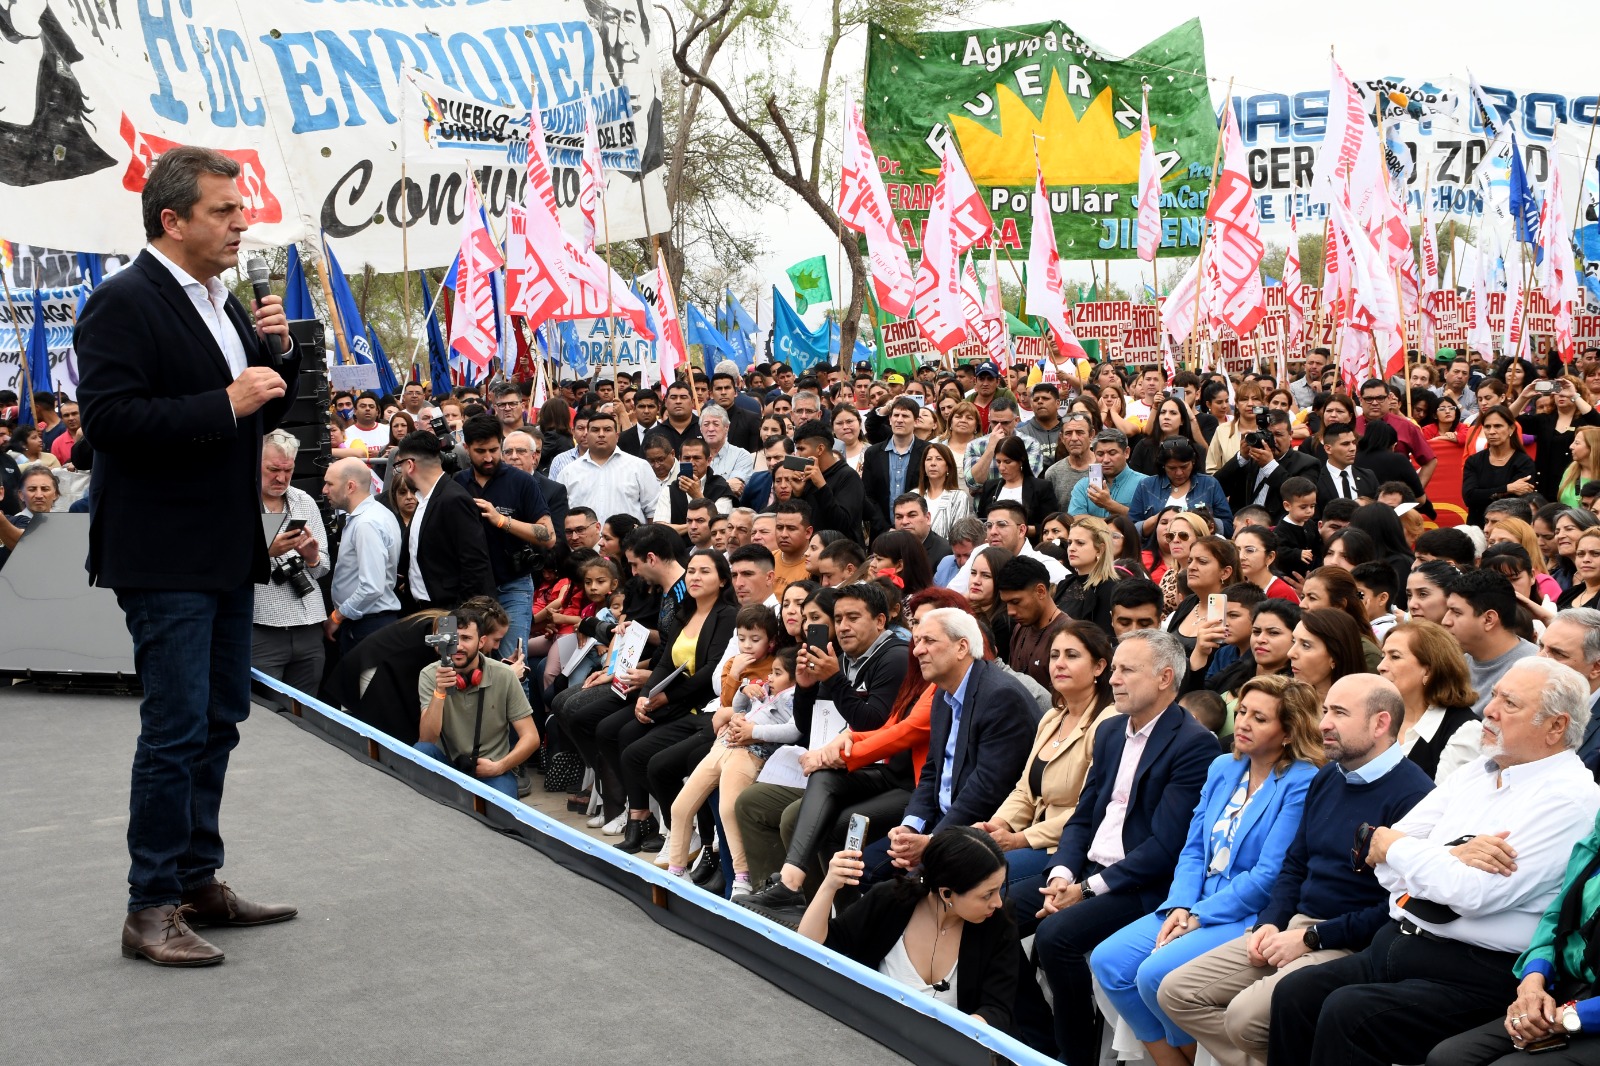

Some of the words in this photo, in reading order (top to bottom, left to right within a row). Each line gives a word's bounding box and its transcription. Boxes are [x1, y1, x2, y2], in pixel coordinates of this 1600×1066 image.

[877, 155, 905, 176] Dr.
[872, 250, 896, 276] Turca
[1076, 301, 1132, 323] ZAMORA
[1077, 324, 1118, 339] CHACO
